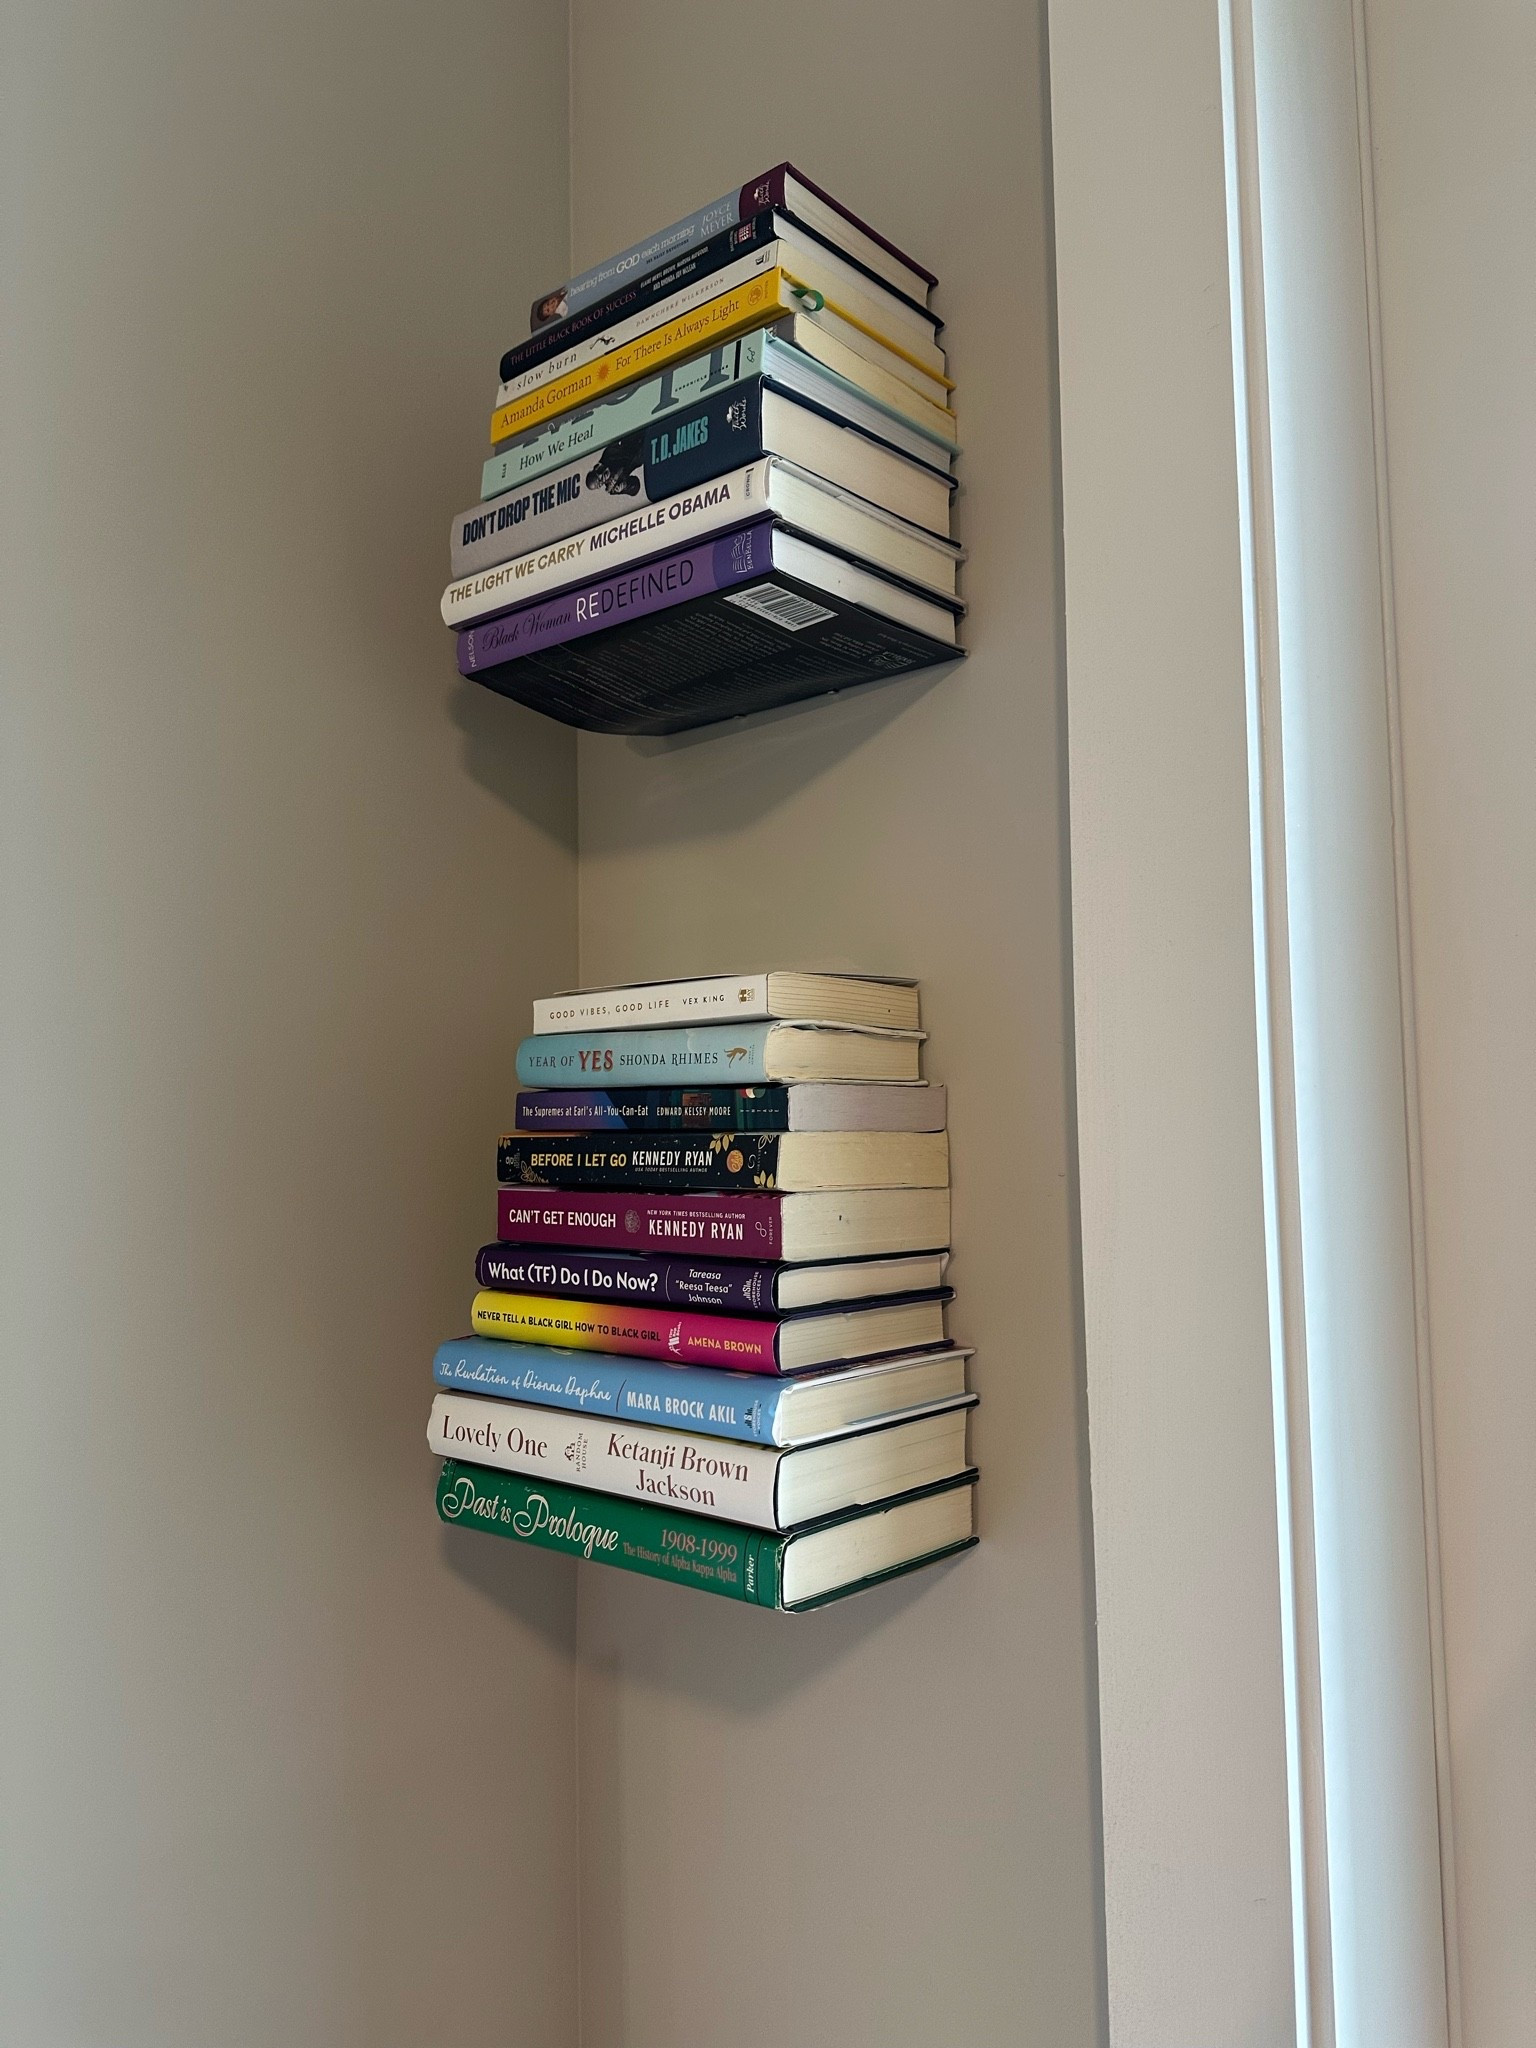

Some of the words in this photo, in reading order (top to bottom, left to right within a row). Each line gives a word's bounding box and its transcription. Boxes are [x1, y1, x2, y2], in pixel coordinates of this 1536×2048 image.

[700, 212, 733, 238] MEYER
[701, 202, 731, 226] JOYCE
[570, 276, 598, 297] hearing
[598, 268, 616, 282] from
[616, 254, 640, 274] GOD
[641, 242, 660, 259] each
[661, 225, 695, 248] morning
[681, 277, 725, 304] WILKERSON
[510, 351, 524, 366] THE
[525, 339, 547, 357] LITTLE
[548, 327, 571, 345] BLACK
[571, 314, 594, 332] BOOK
[593, 308, 605, 321] OF
[605, 290, 637, 312] SUCCESS
[615, 353, 631, 371] For
[633, 338, 662, 361] There
[664, 330, 673, 347] Is
[673, 315, 710, 341] Always
[712, 299, 740, 321] Light
[516, 370, 543, 391] slow
[548, 352, 577, 374] burn
[500, 396, 545, 428] Amanda
[546, 375, 592, 406] Gorman
[519, 451, 544, 471] How
[547, 440, 565, 457] We
[568, 424, 594, 448] Heal
[651, 433, 671, 465] T.D.
[672, 415, 708, 456] JAKES
[463, 511, 496, 546] DON'T
[497, 496, 530, 532] DROP
[532, 484, 555, 516] THE
[556, 473, 581, 501] MIC
[590, 508, 665, 551] MICHELLE
[668, 484, 731, 520] OBAMA
[450, 583, 472, 603] THE
[474, 567, 513, 595] LIGHT
[514, 559, 535, 579] WE
[537, 539, 586, 570] CARRY
[482, 622, 519, 652] Black
[522, 601, 571, 636] Woman
[576, 559, 694, 622] REDEFINED
[468, 630, 477, 668] NELSON
[549, 1010, 575, 1020] GOOD
[580, 1006, 611, 1016] VIBES,
[615, 1002, 643, 1013] GOOD
[648, 999, 670, 1010] LIFE
[682, 997, 699, 1005] VEX
[703, 994, 725, 1003] KING
[529, 1056, 556, 1068] YEAR
[560, 1055, 575, 1067] OF
[578, 1050, 614, 1072] YES
[619, 1052, 666, 1066] SHONDA
[671, 1052, 719, 1066] RHIMES
[522, 1106, 533, 1116] The
[534, 1106, 564, 1118] Supremes
[565, 1107, 572, 1116] at
[573, 1106, 592, 1116] Earl's
[594, 1105, 648, 1116] All-You-Can-Eat
[656, 1107, 682, 1116] EDWARD
[684, 1107, 707, 1116] KELSEY
[709, 1106, 731, 1116] MOORE
[530, 1153, 574, 1166] BEFORE
[577, 1153, 581, 1166] I
[584, 1153, 607, 1167] LET
[610, 1153, 627, 1167] GO
[632, 1151, 681, 1166] KENNEDY
[684, 1151, 713, 1166] RYAN
[509, 1209, 540, 1223] CAN'T
[543, 1211, 564, 1225] GET
[567, 1212, 616, 1228] ENOUGH
[649, 1219, 705, 1238] KENNEDY
[711, 1222, 743, 1240] RYAN
[488, 1262, 525, 1281] What
[528, 1263, 557, 1285] (TF)
[560, 1267, 580, 1286] Do
[584, 1268, 588, 1287] I
[592, 1270, 613, 1288] Do
[616, 1271, 658, 1292] Now?
[689, 1269, 721, 1280] Tareasa
[688, 1293, 723, 1305] Johnson
[477, 1310, 501, 1321] NEVER
[502, 1313, 519, 1324] TELL
[520, 1315, 526, 1325] A
[528, 1316, 553, 1328] BLACK
[555, 1319, 573, 1330] GIRL
[575, 1322, 595, 1333] HOW
[597, 1324, 609, 1335] TO
[611, 1326, 639, 1339] BLACK
[641, 1330, 661, 1341] GIRL
[688, 1336, 721, 1350] AMENA
[724, 1340, 762, 1354] BROWN
[439, 1362, 452, 1376] The
[454, 1359, 509, 1385] Revelation
[511, 1375, 520, 1390] of
[523, 1369, 563, 1393] Dionne
[565, 1376, 612, 1405] Daphne
[627, 1391, 660, 1412] MARA
[665, 1397, 704, 1419] BROCK
[709, 1404, 737, 1425] AKIL
[442, 1415, 502, 1453] Lovely
[507, 1427, 548, 1458] One
[576, 1432, 584, 1472] RANDOM
[607, 1433, 676, 1470] Ketanji
[680, 1446, 748, 1482] Brown
[636, 1469, 715, 1507] Jackson
[442, 1477, 500, 1518] Past
[500, 1499, 511, 1523] is
[512, 1494, 619, 1559] Prologue
[623, 1542, 636, 1556] The
[636, 1545, 660, 1566] History
[662, 1552, 670, 1565] of
[671, 1554, 691, 1571] Alpha
[692, 1560, 714, 1579] Kappa
[716, 1565, 737, 1583] Alpha
[661, 1529, 738, 1565] 1908-1999
[746, 1554, 755, 1593] Parker
